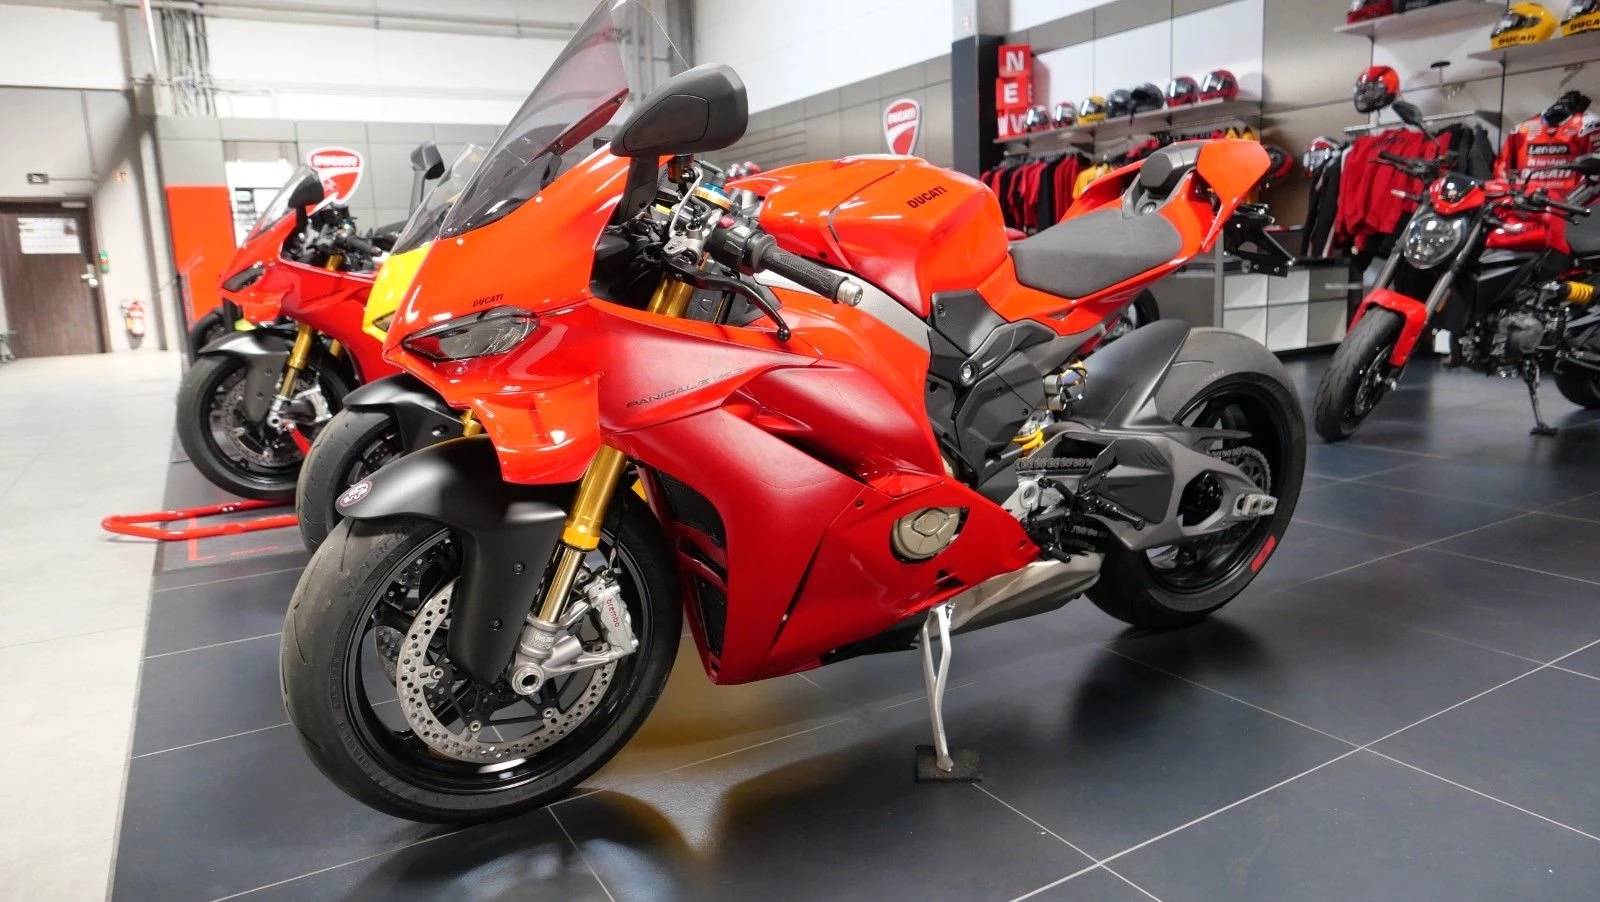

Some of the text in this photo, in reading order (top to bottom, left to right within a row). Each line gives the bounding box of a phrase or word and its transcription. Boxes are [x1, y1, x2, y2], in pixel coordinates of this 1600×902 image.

[1528, 145, 1568, 155] Lenovo
[906, 186, 948, 209] DUCATI
[472, 293, 504, 308] DUCATI
[626, 378, 711, 408] PANIGALE
[606, 599, 620, 628] brembo
